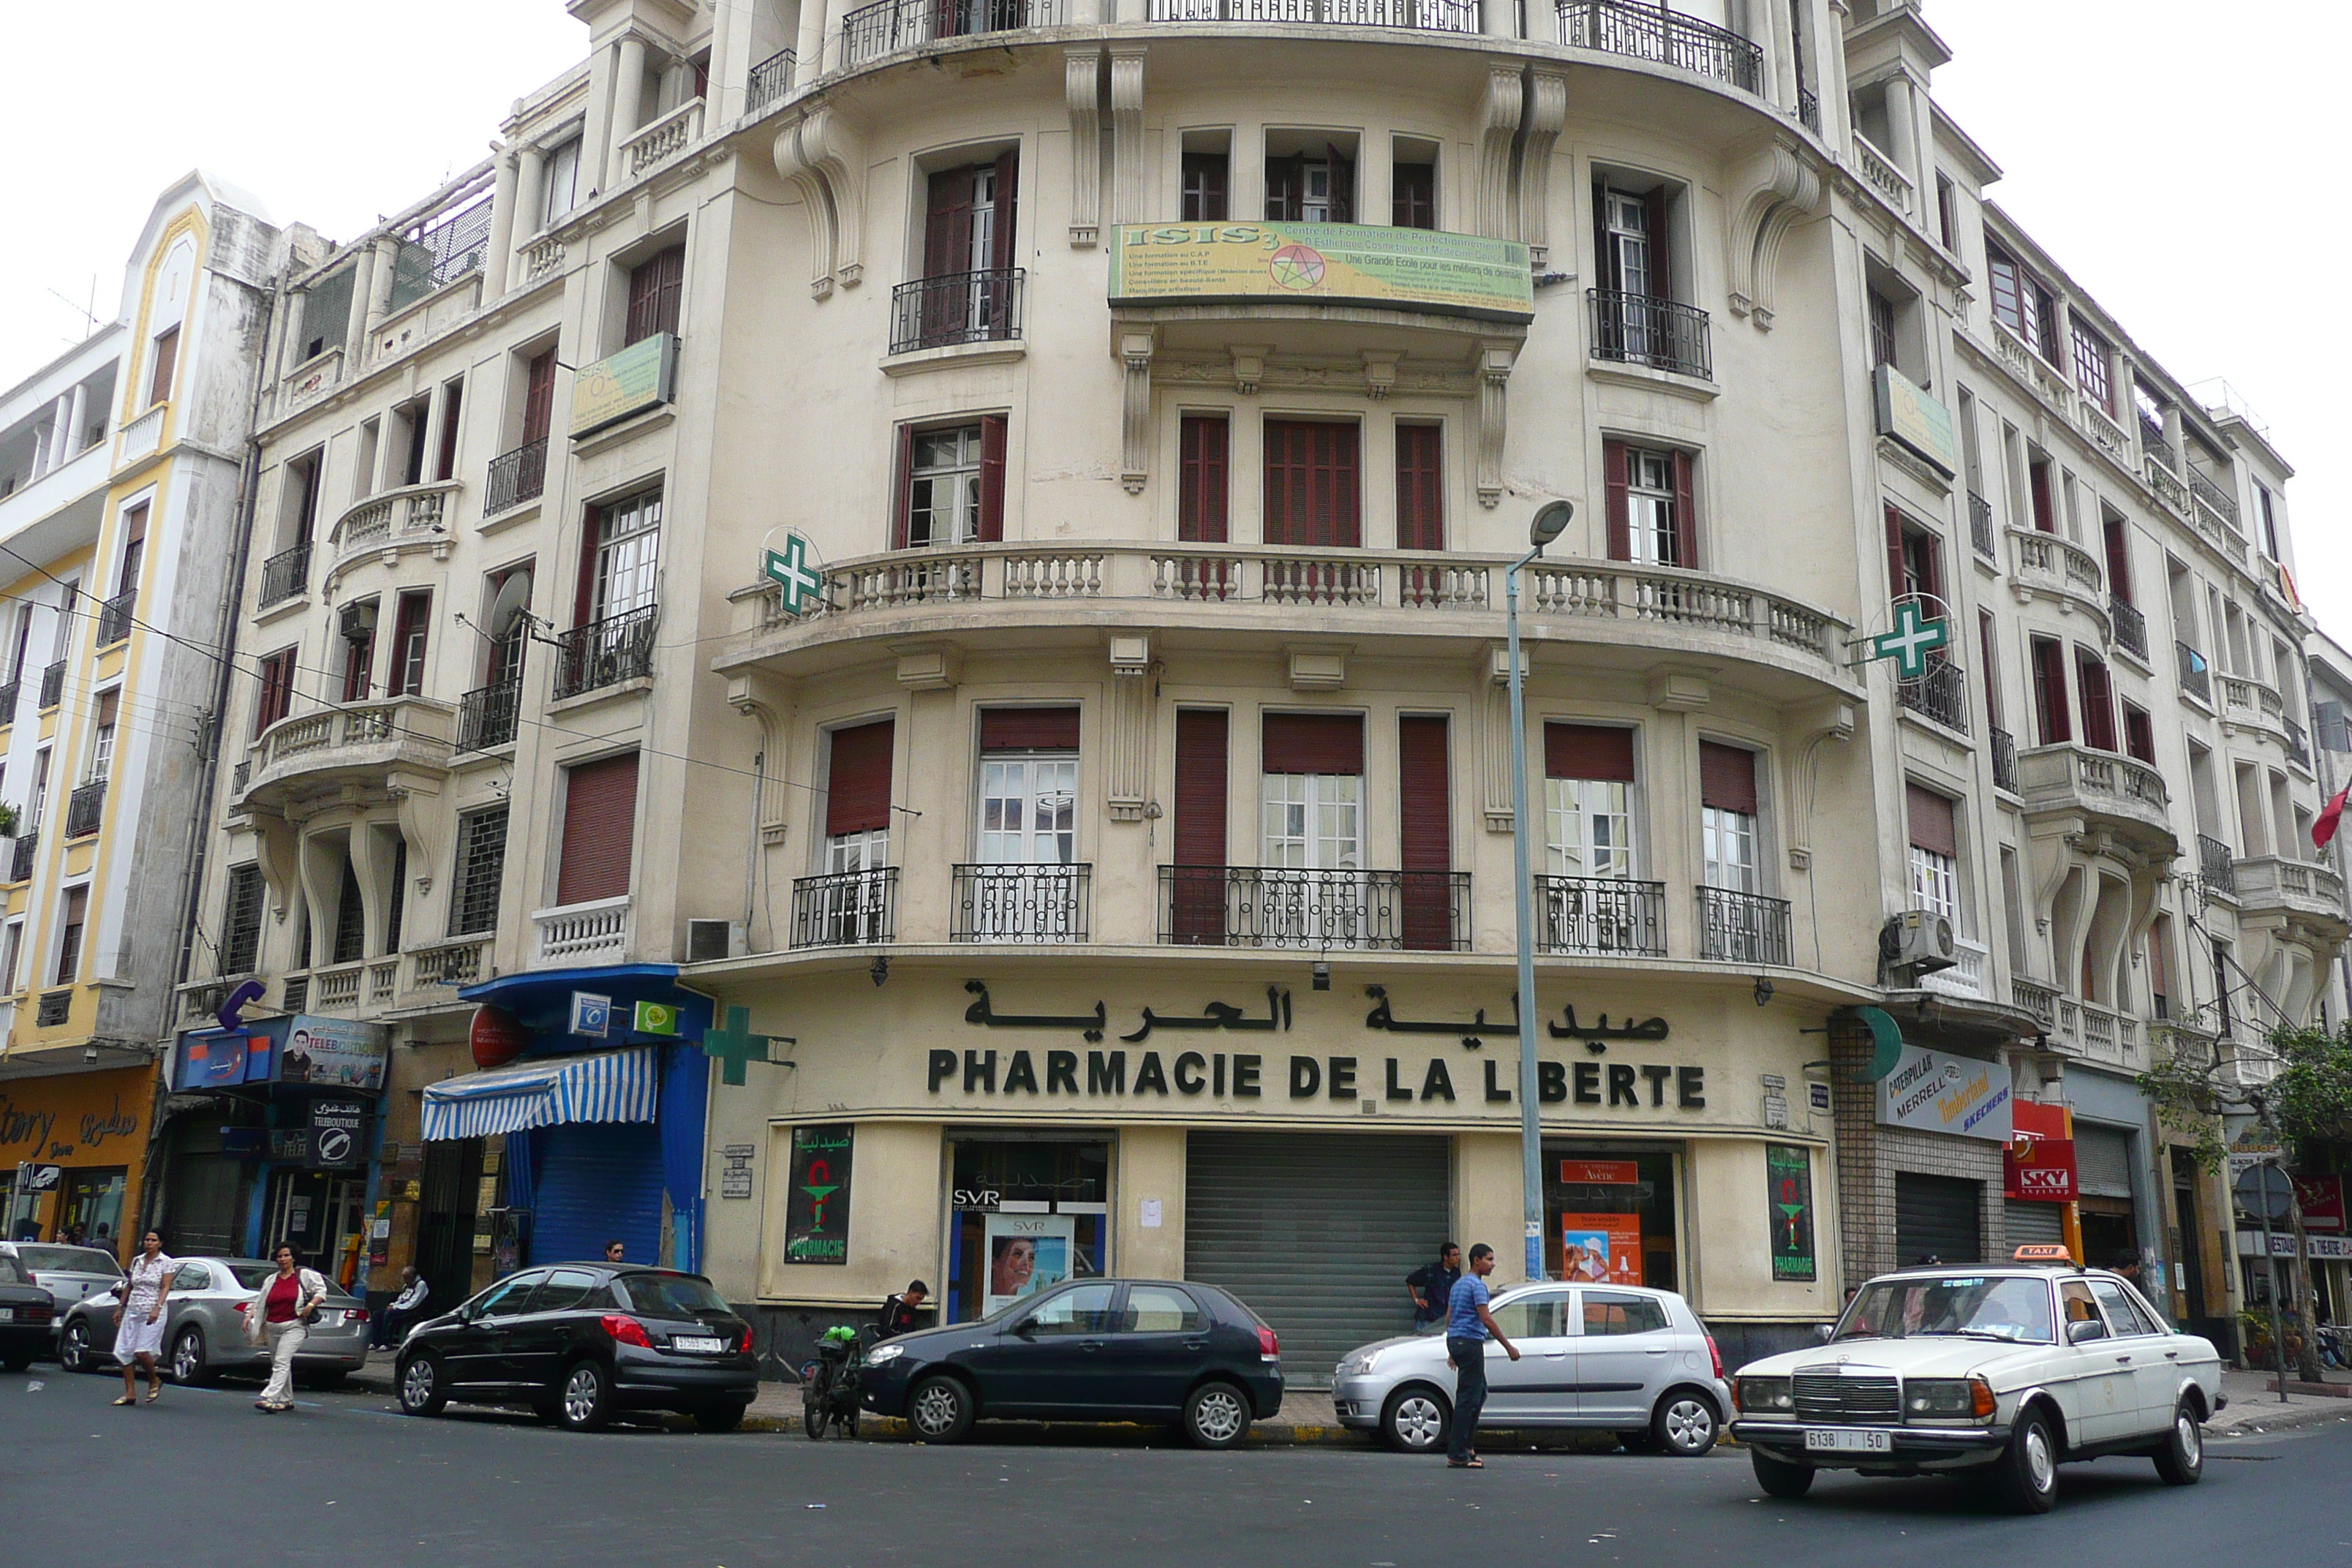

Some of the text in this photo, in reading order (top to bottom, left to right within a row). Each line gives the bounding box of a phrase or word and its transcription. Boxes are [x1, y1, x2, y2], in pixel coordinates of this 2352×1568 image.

[1126, 227, 1260, 246] ISIS
[1284, 225, 1501, 251] Centre de Formation de Perfectionnement
[1475, 251, 1502, 262] Douce
[1346, 254, 1362, 264] Une
[1364, 255, 1394, 266] Grande
[1396, 257, 1418, 268] Ecole
[1420, 259, 1437, 271] pour
[1440, 261, 1451, 271] les
[1453, 263, 1482, 275] métiers
[1483, 266, 1493, 276] de
[1495, 267, 1523, 280] demain
[965, 980, 1292, 1043] الحرية
[927, 1048, 1706, 1109] PHARMACIE DE LA LBERTE
[1888, 1053, 1933, 1098] CATERPILLAR
[1896, 1077, 1946, 1120] MERRELL
[1937, 1066, 1989, 1124] Timberland
[1964, 1086, 2009, 1132] SKECHERS
[314, 1117, 360, 1128] TELEBOUTIQUE
[796, 1134, 849, 1153] صيدلية
[2023, 1171, 2065, 1187] SKY
[954, 1189, 1000, 1205] SVR
[1014, 1221, 1045, 1232] SVR
[788, 1238, 844, 1256] PHARMACIE
[1775, 1256, 1813, 1273] PHARMACIE
[1867, 1433, 1882, 1448] 50
